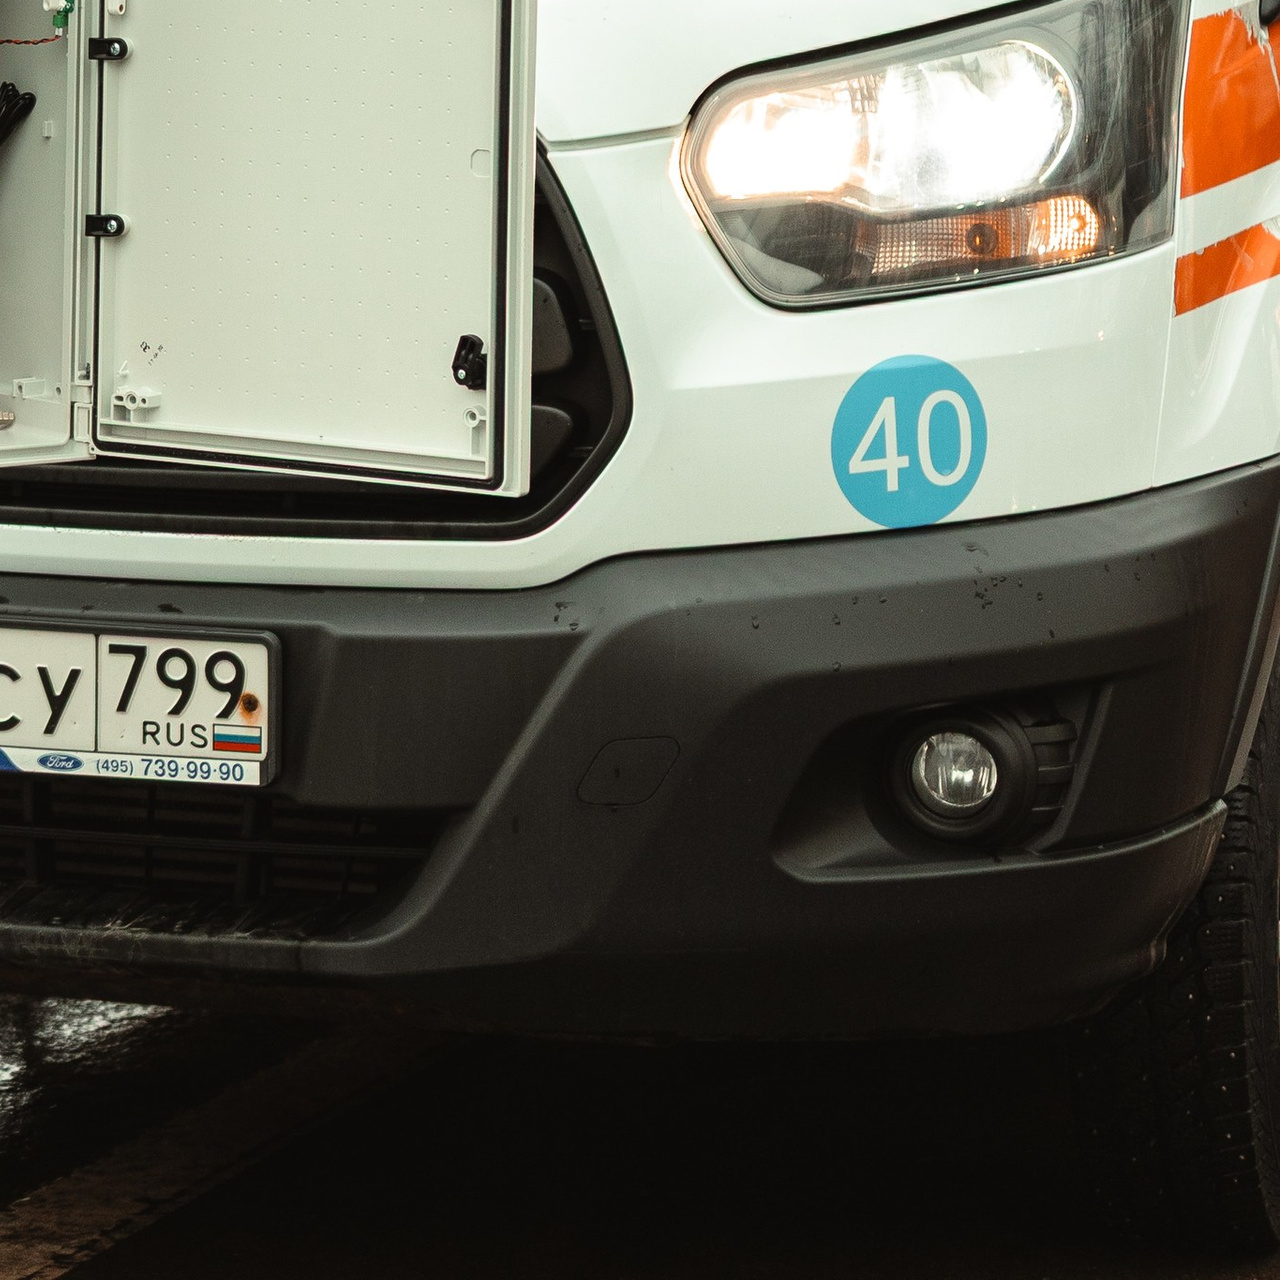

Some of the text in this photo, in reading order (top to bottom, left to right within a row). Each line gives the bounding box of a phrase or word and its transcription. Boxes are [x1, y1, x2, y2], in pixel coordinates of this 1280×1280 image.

[849, 391, 972, 492] 40
[108, 643, 246, 720] 799
[142, 720, 208, 749] RUS
[96, 758, 134, 776] (495)
